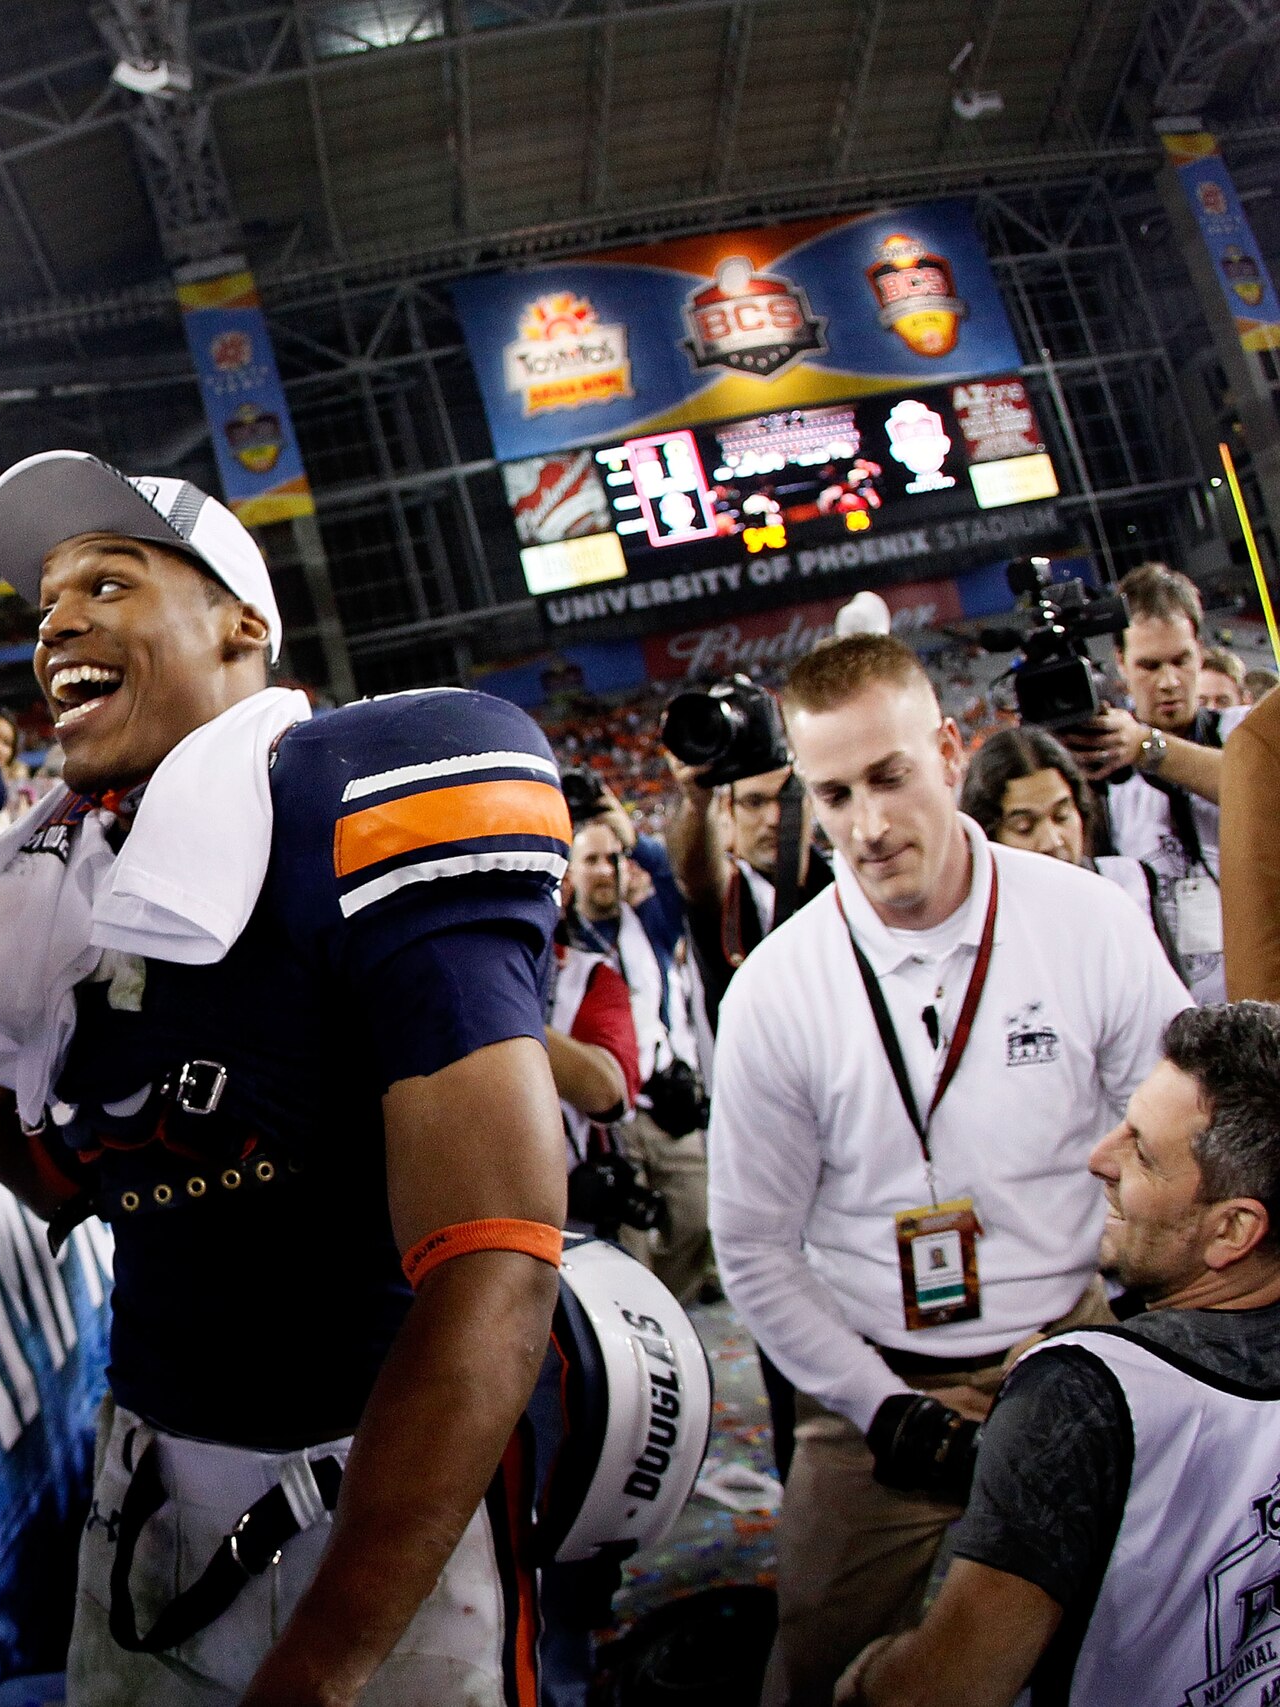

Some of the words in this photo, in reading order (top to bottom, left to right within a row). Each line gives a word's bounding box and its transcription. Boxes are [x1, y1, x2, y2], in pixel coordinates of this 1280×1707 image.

[695, 298, 801, 342] BCS
[880, 266, 948, 303] BCS
[546, 562, 743, 625] UNIVERSITY
[747, 553, 792, 586] OF
[796, 529, 930, 577] PHOENIX
[935, 506, 1060, 549] STADIUM
[621, 1309, 680, 1500] DOUGLAS
